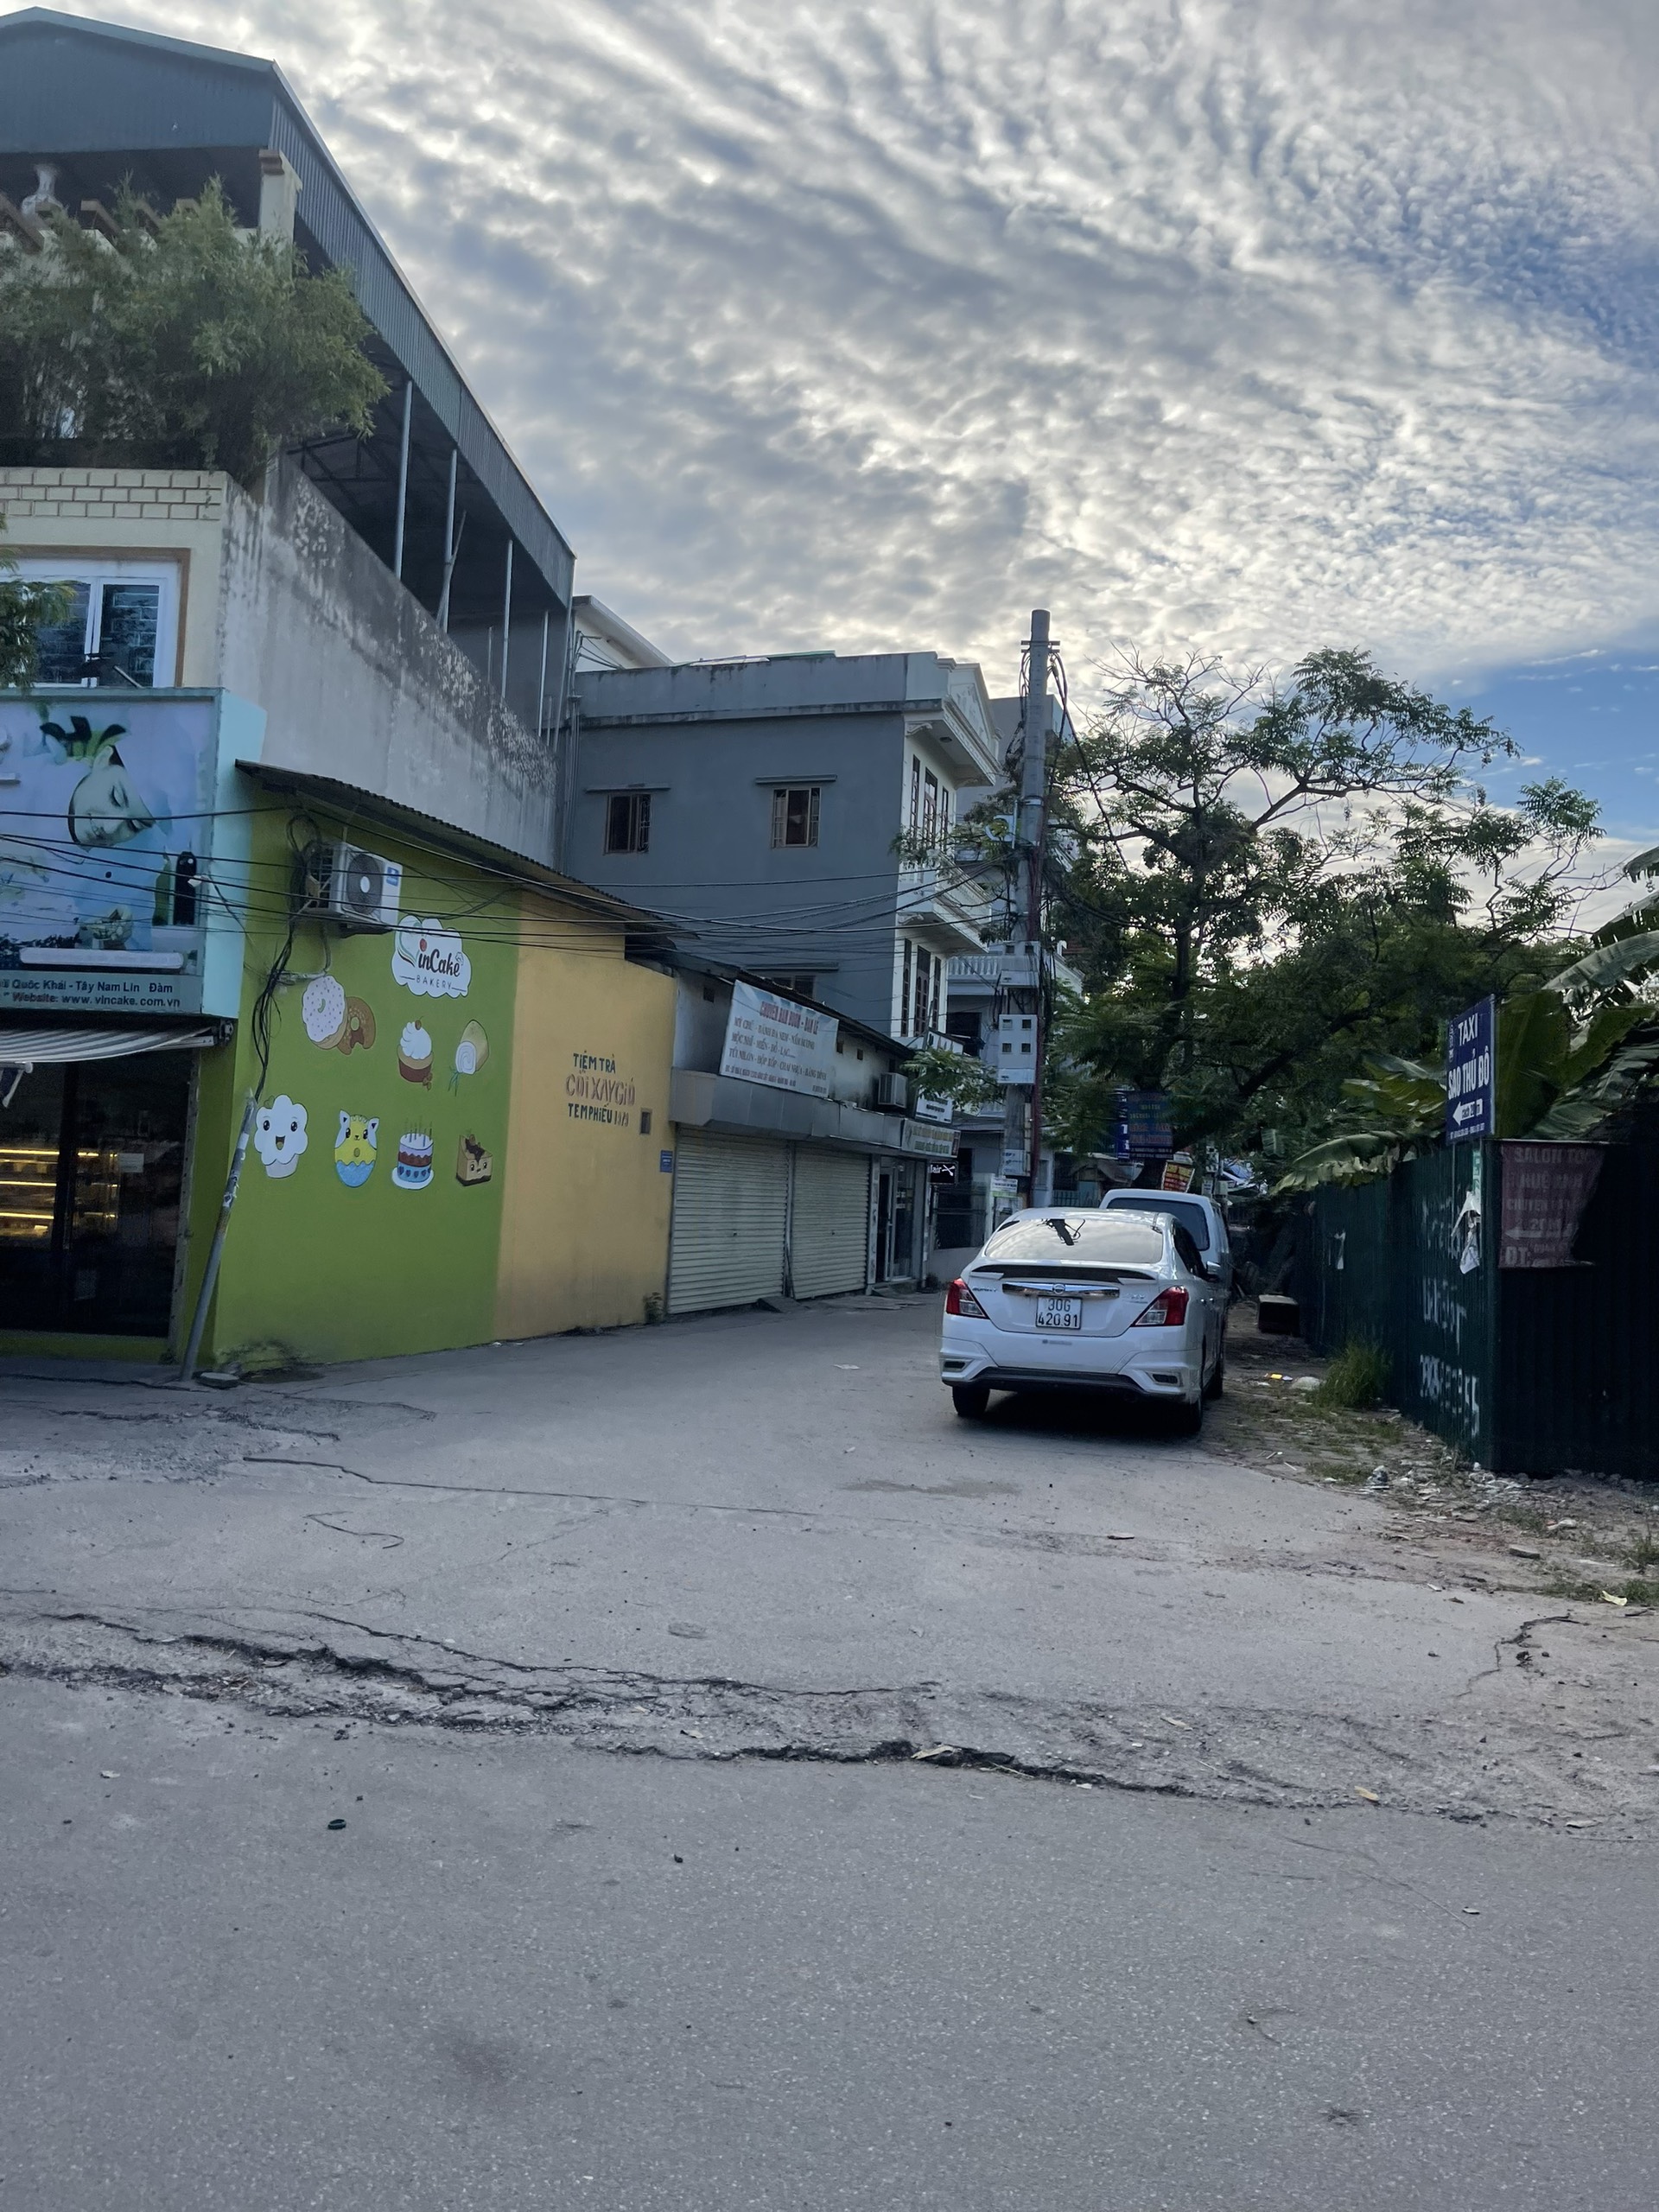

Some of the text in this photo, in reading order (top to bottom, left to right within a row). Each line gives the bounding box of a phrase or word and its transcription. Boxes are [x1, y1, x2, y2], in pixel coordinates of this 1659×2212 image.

[12, 978, 40, 989] Quốc
[75, 981, 95, 993] Tây
[97, 982, 121, 992] Nam
[149, 982, 173, 993] Đàm
[416, 975, 452, 990] BAKERY
[1458, 1013, 1478, 1046] TAXI
[1448, 1045, 1490, 1100] SAO THỦ ĐÔ
[1514, 1147, 1562, 1164] SALON
[1046, 1298, 1071, 1313] 30G
[1038, 1313, 1079, 1328] 420.91
